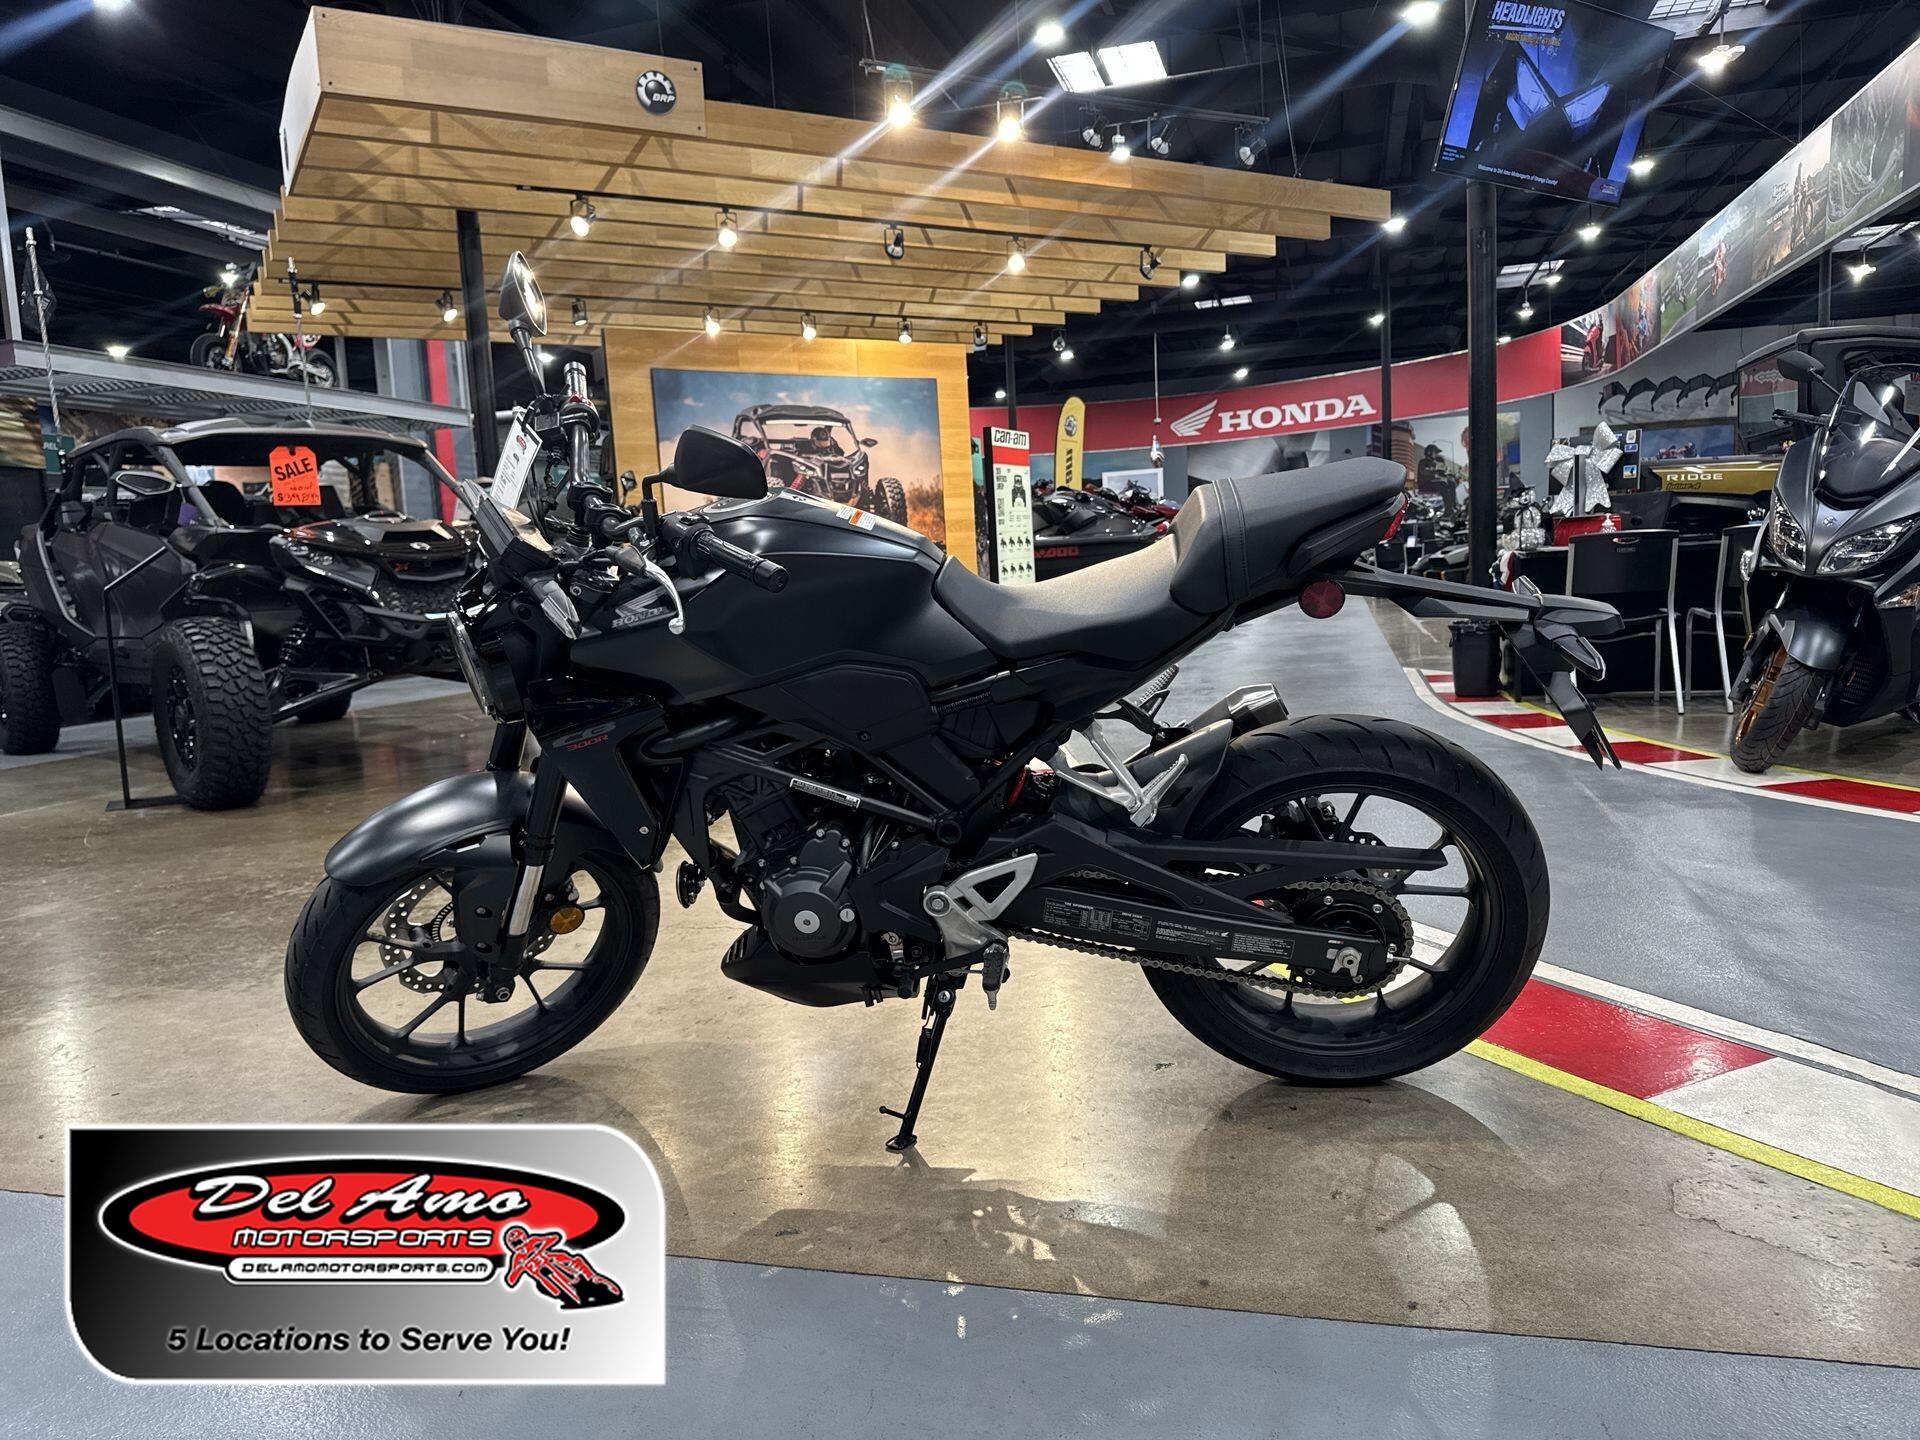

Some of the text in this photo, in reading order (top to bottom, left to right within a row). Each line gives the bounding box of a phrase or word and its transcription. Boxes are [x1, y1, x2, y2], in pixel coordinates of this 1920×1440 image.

[1491, 1, 1566, 29] HEADLIGHTS
[652, 92, 676, 103] BRP
[1218, 393, 1377, 433] HONDA
[994, 429, 1027, 446] can-am
[274, 457, 313, 481] SALE
[1666, 473, 1723, 481] RIDGE
[611, 606, 671, 629] HONDA
[566, 734, 609, 751] 300R
